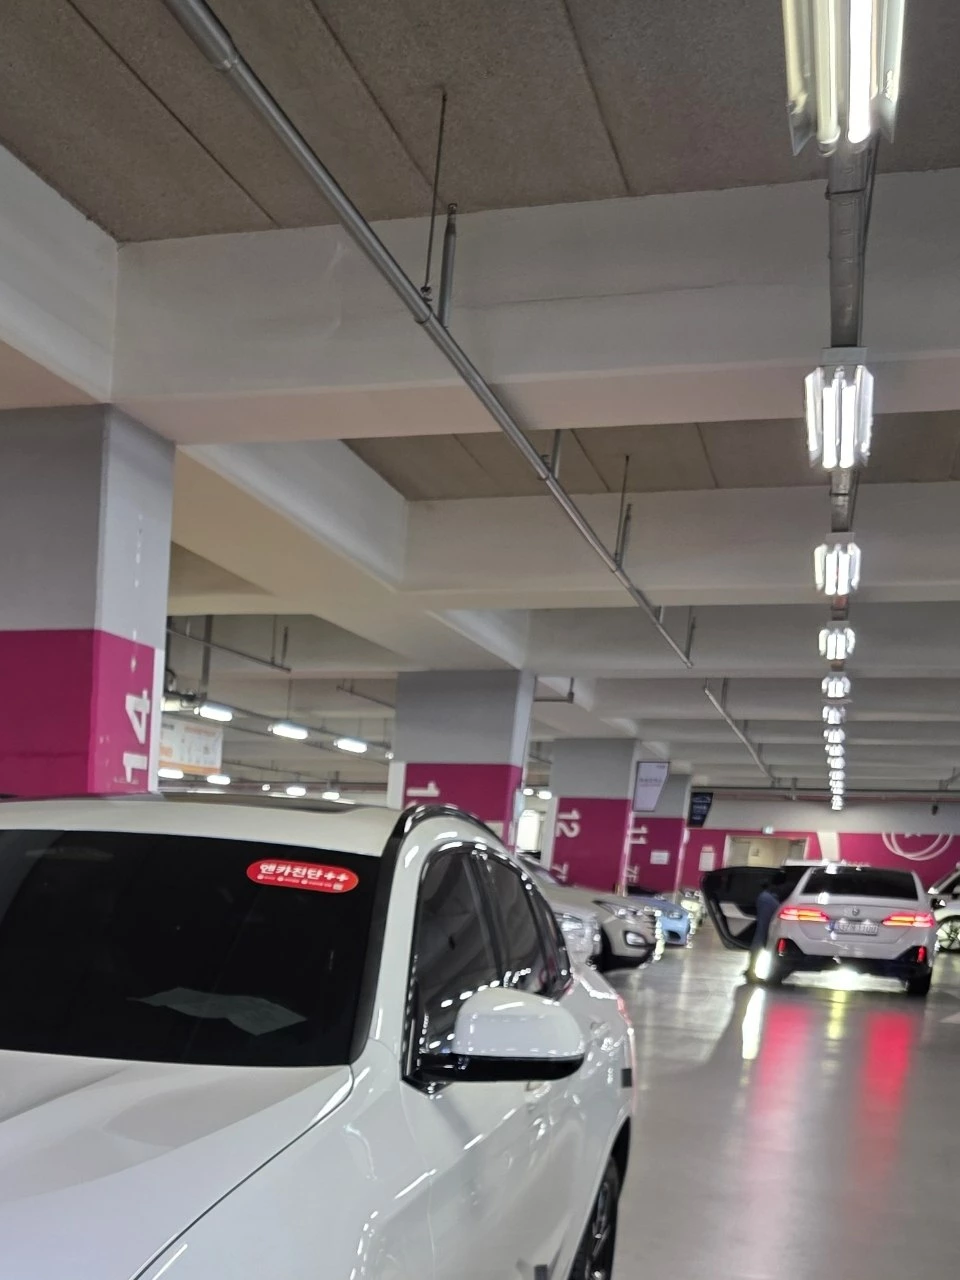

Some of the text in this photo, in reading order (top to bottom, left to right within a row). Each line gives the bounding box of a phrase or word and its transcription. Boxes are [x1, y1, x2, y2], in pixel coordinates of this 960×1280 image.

[123, 689, 150, 783] 14
[555, 809, 581, 838] 12
[628, 825, 648, 845] 11
